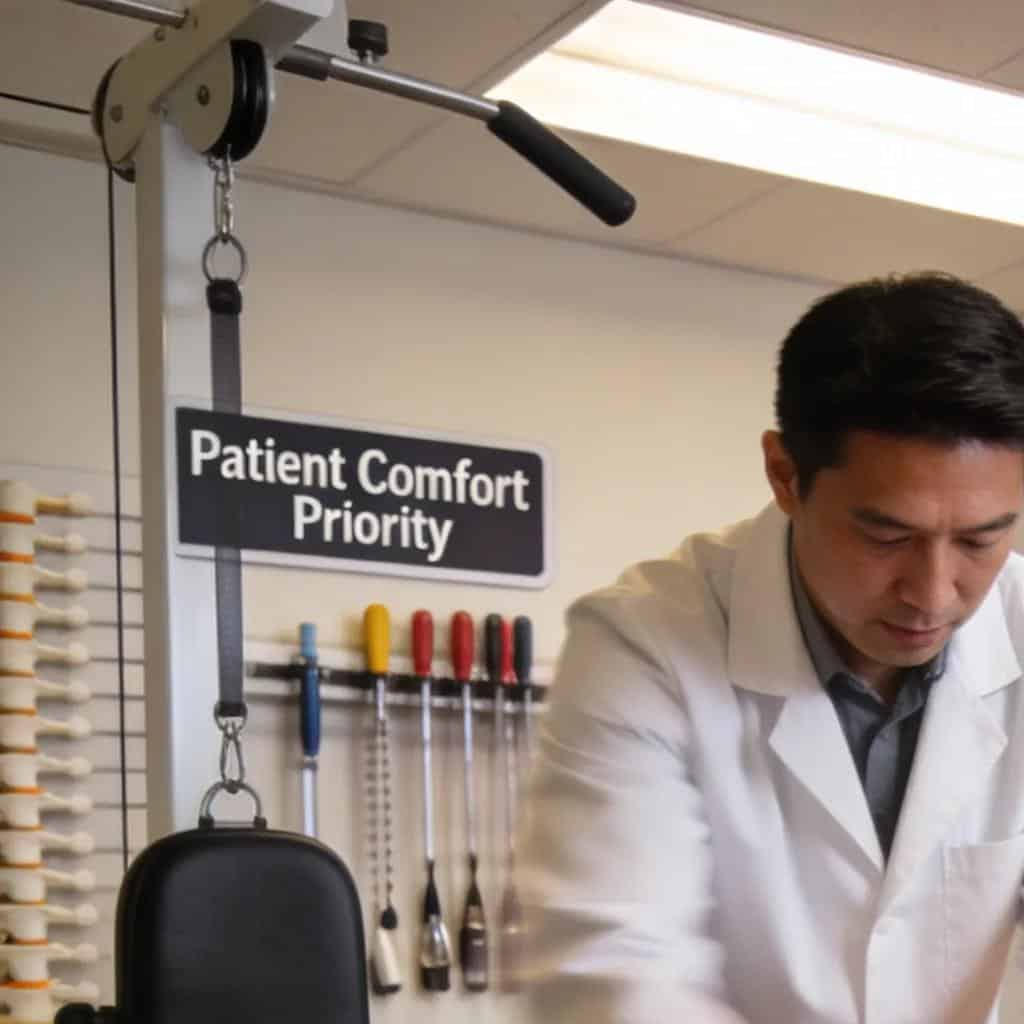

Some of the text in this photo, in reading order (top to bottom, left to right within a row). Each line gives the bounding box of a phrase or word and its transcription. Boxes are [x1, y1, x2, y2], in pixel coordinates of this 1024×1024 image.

[190, 429, 530, 511] Patient Comfort
[293, 495, 453, 562] Priority
